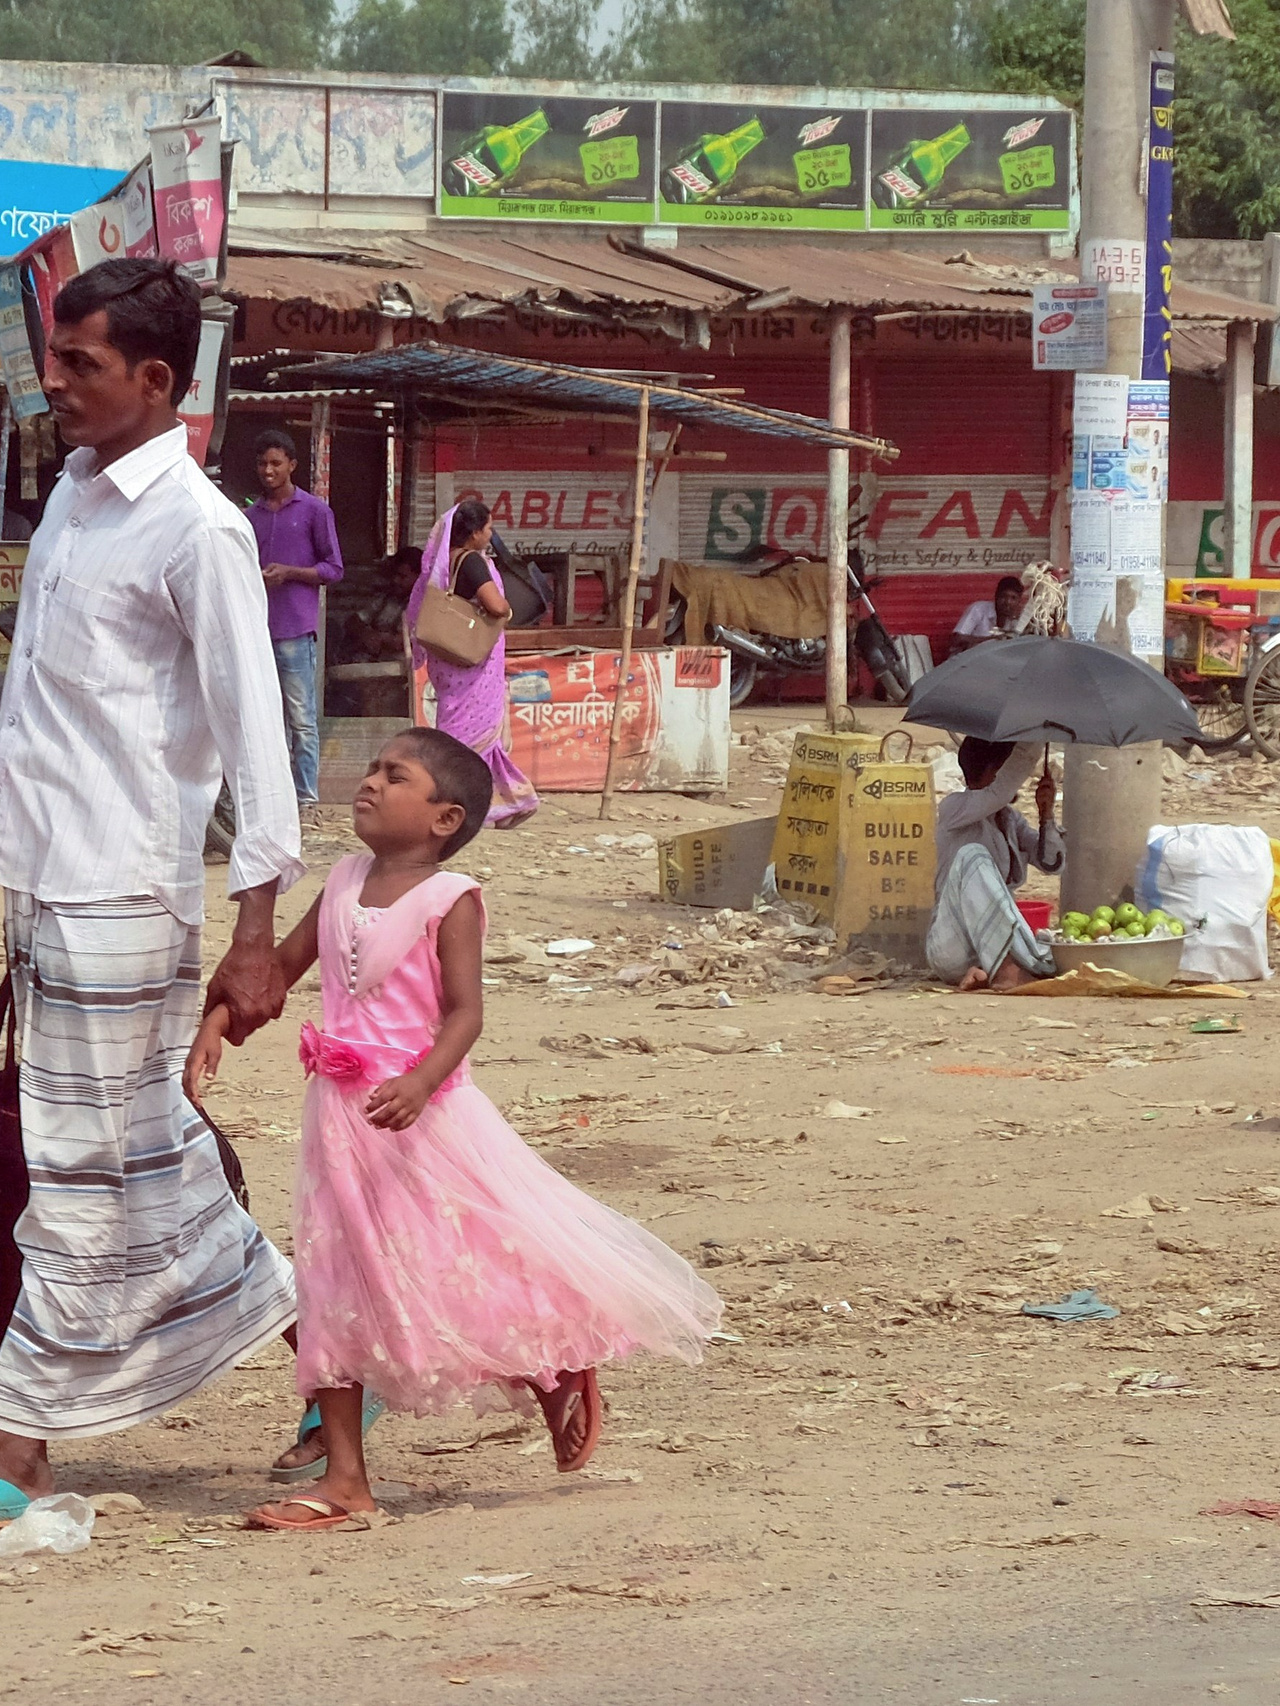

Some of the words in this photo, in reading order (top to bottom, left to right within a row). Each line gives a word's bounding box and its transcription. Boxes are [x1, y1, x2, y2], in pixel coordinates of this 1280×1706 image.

[592, 161, 617, 180] ১৫
[804, 169, 830, 188] ১৫
[1011, 171, 1034, 190] ১৫
[1093, 247, 1142, 263] 1A-3-6
[866, 489, 1058, 539] FAN
[914, 546, 961, 567] Safety
[966, 548, 979, 563] &
[982, 547, 1035, 567] Quality
[515, 692, 642, 728] বাংলালিক
[808, 750, 839, 762] BSRM
[790, 775, 835, 802] পুলিশকে
[883, 781, 926, 793] BSRM
[865, 822, 923, 839] BUILD
[693, 840, 706, 894] BUILD
[788, 852, 818, 876] করুন
[869, 850, 918, 866] SAFE
[869, 905, 917, 920] SAFE
